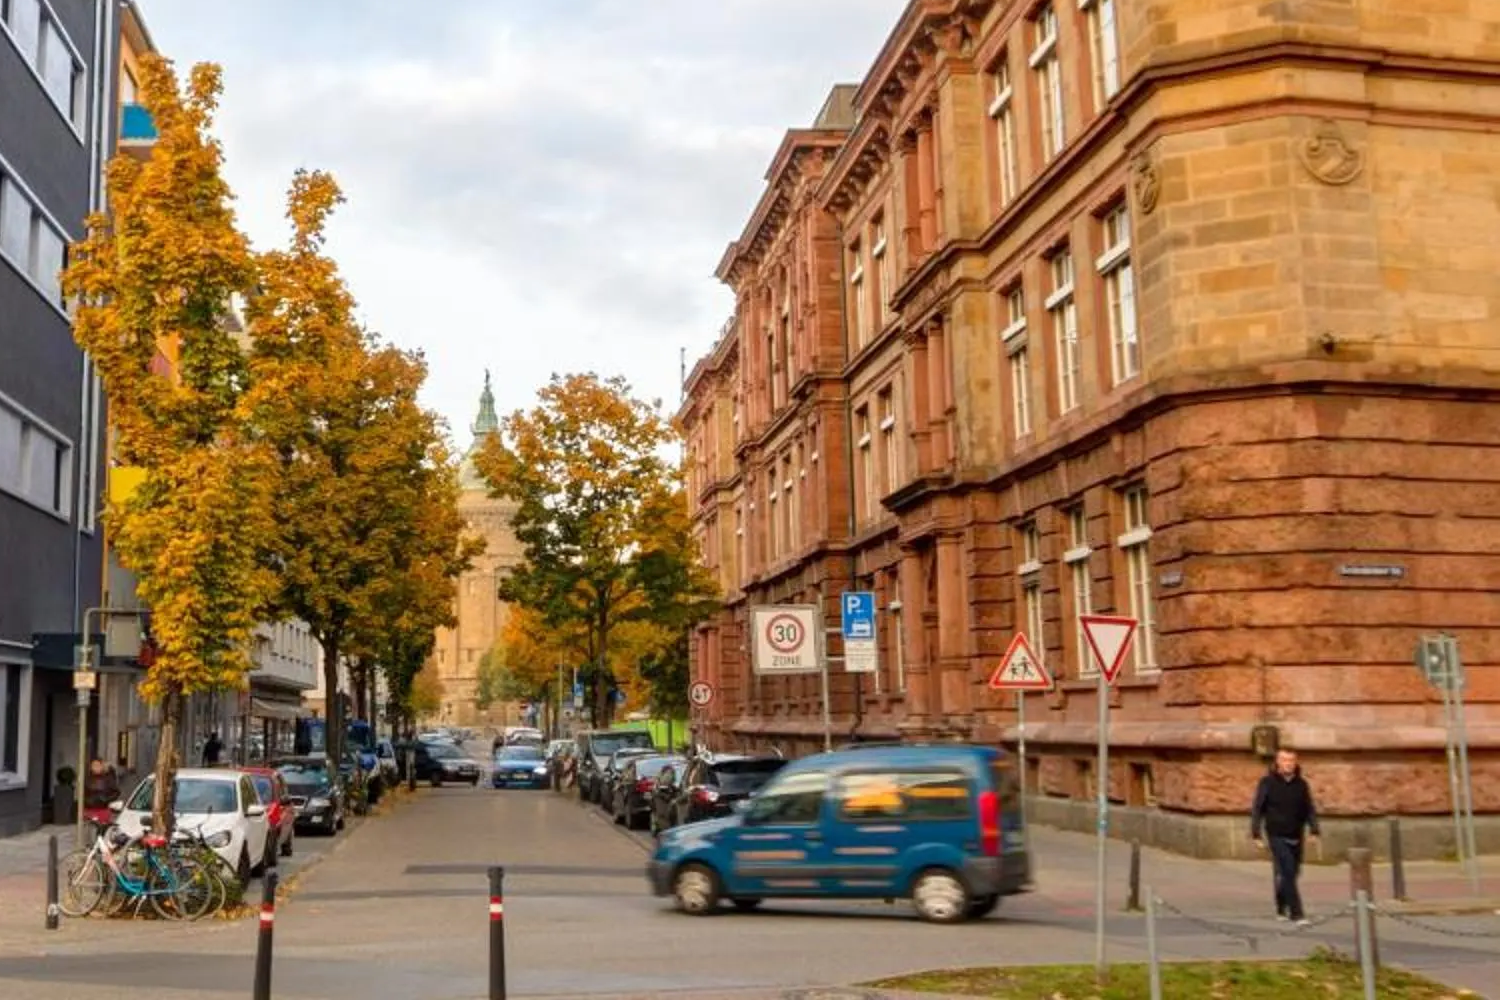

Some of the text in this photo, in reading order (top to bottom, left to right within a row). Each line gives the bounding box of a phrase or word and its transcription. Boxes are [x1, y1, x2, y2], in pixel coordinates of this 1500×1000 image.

[847, 596, 861, 615] P
[774, 624, 798, 643] 30
[772, 655, 802, 667] ZONE
